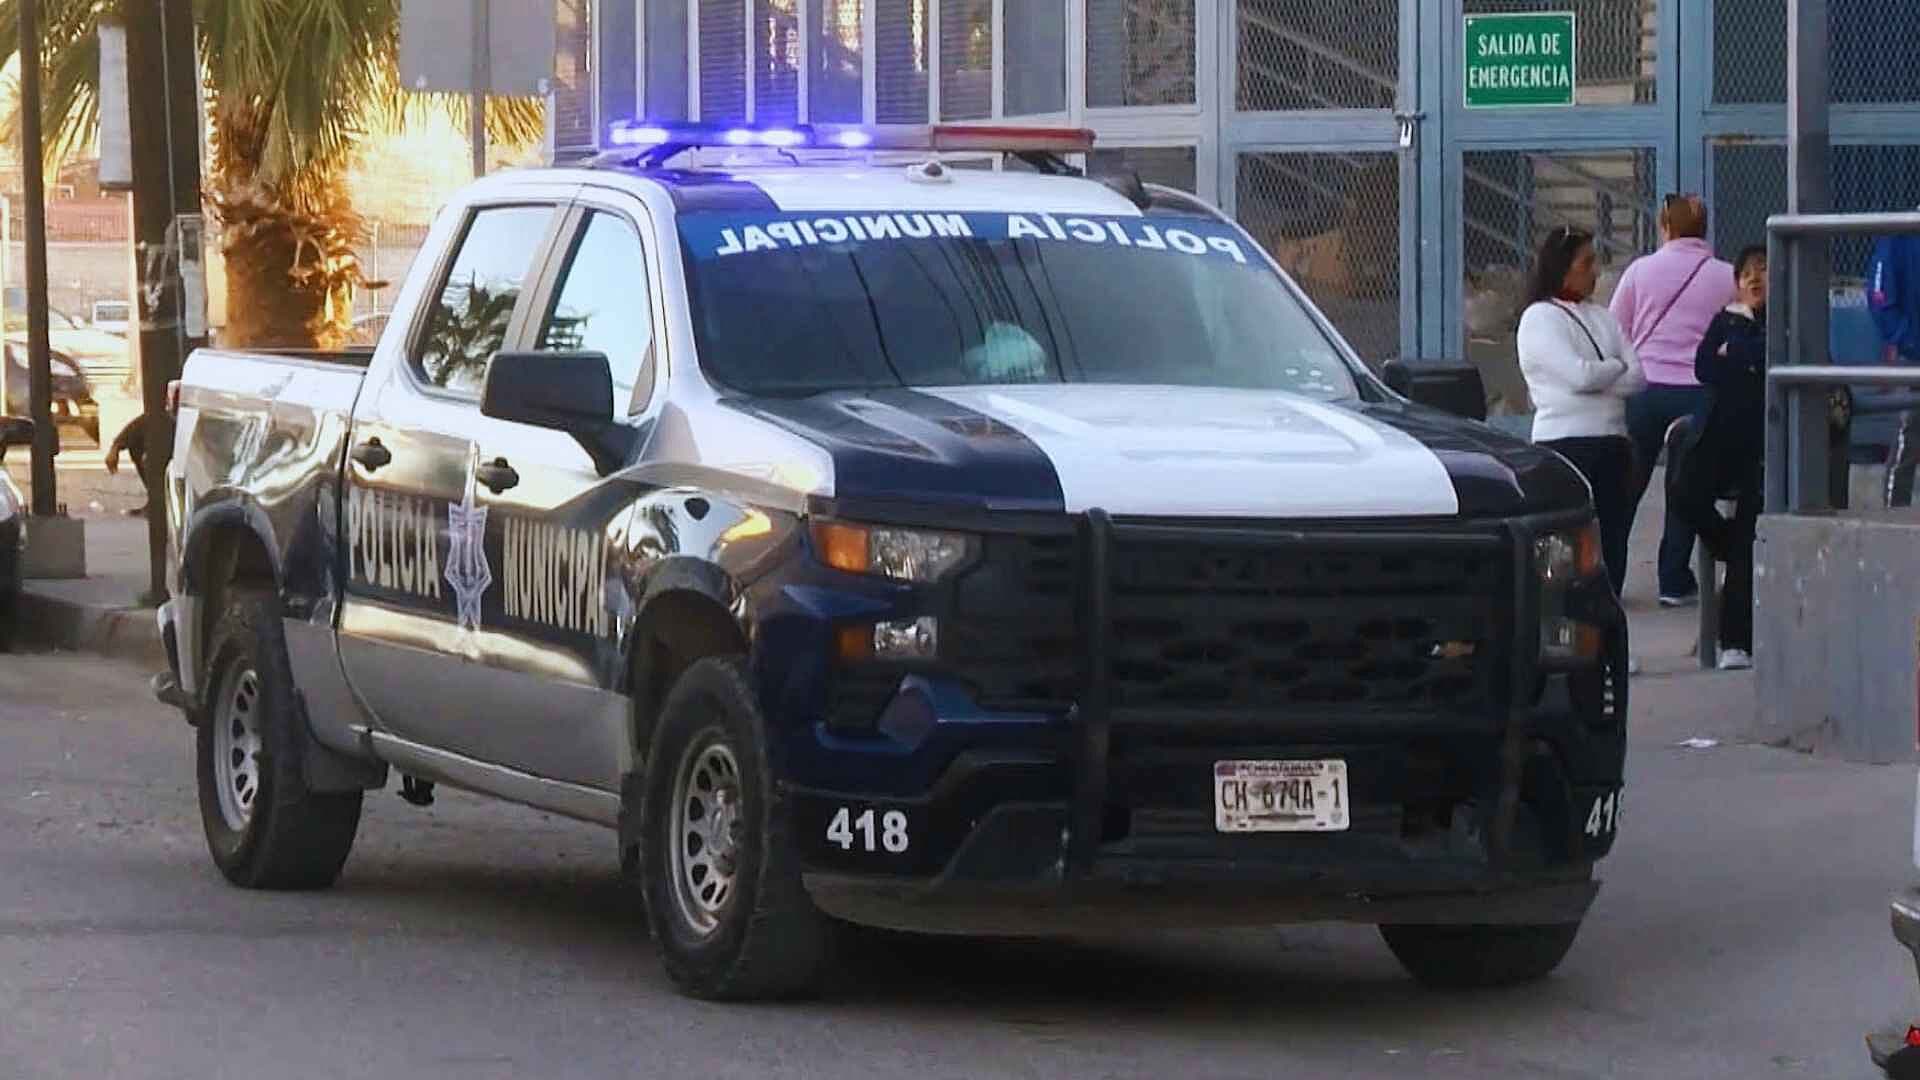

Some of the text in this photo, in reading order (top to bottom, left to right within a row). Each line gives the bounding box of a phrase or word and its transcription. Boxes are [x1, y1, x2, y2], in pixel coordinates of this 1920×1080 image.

[1478, 32, 1561, 56] SALIDA DE
[1469, 64, 1569, 88] EMERGENCIA
[827, 807, 908, 852] 418
